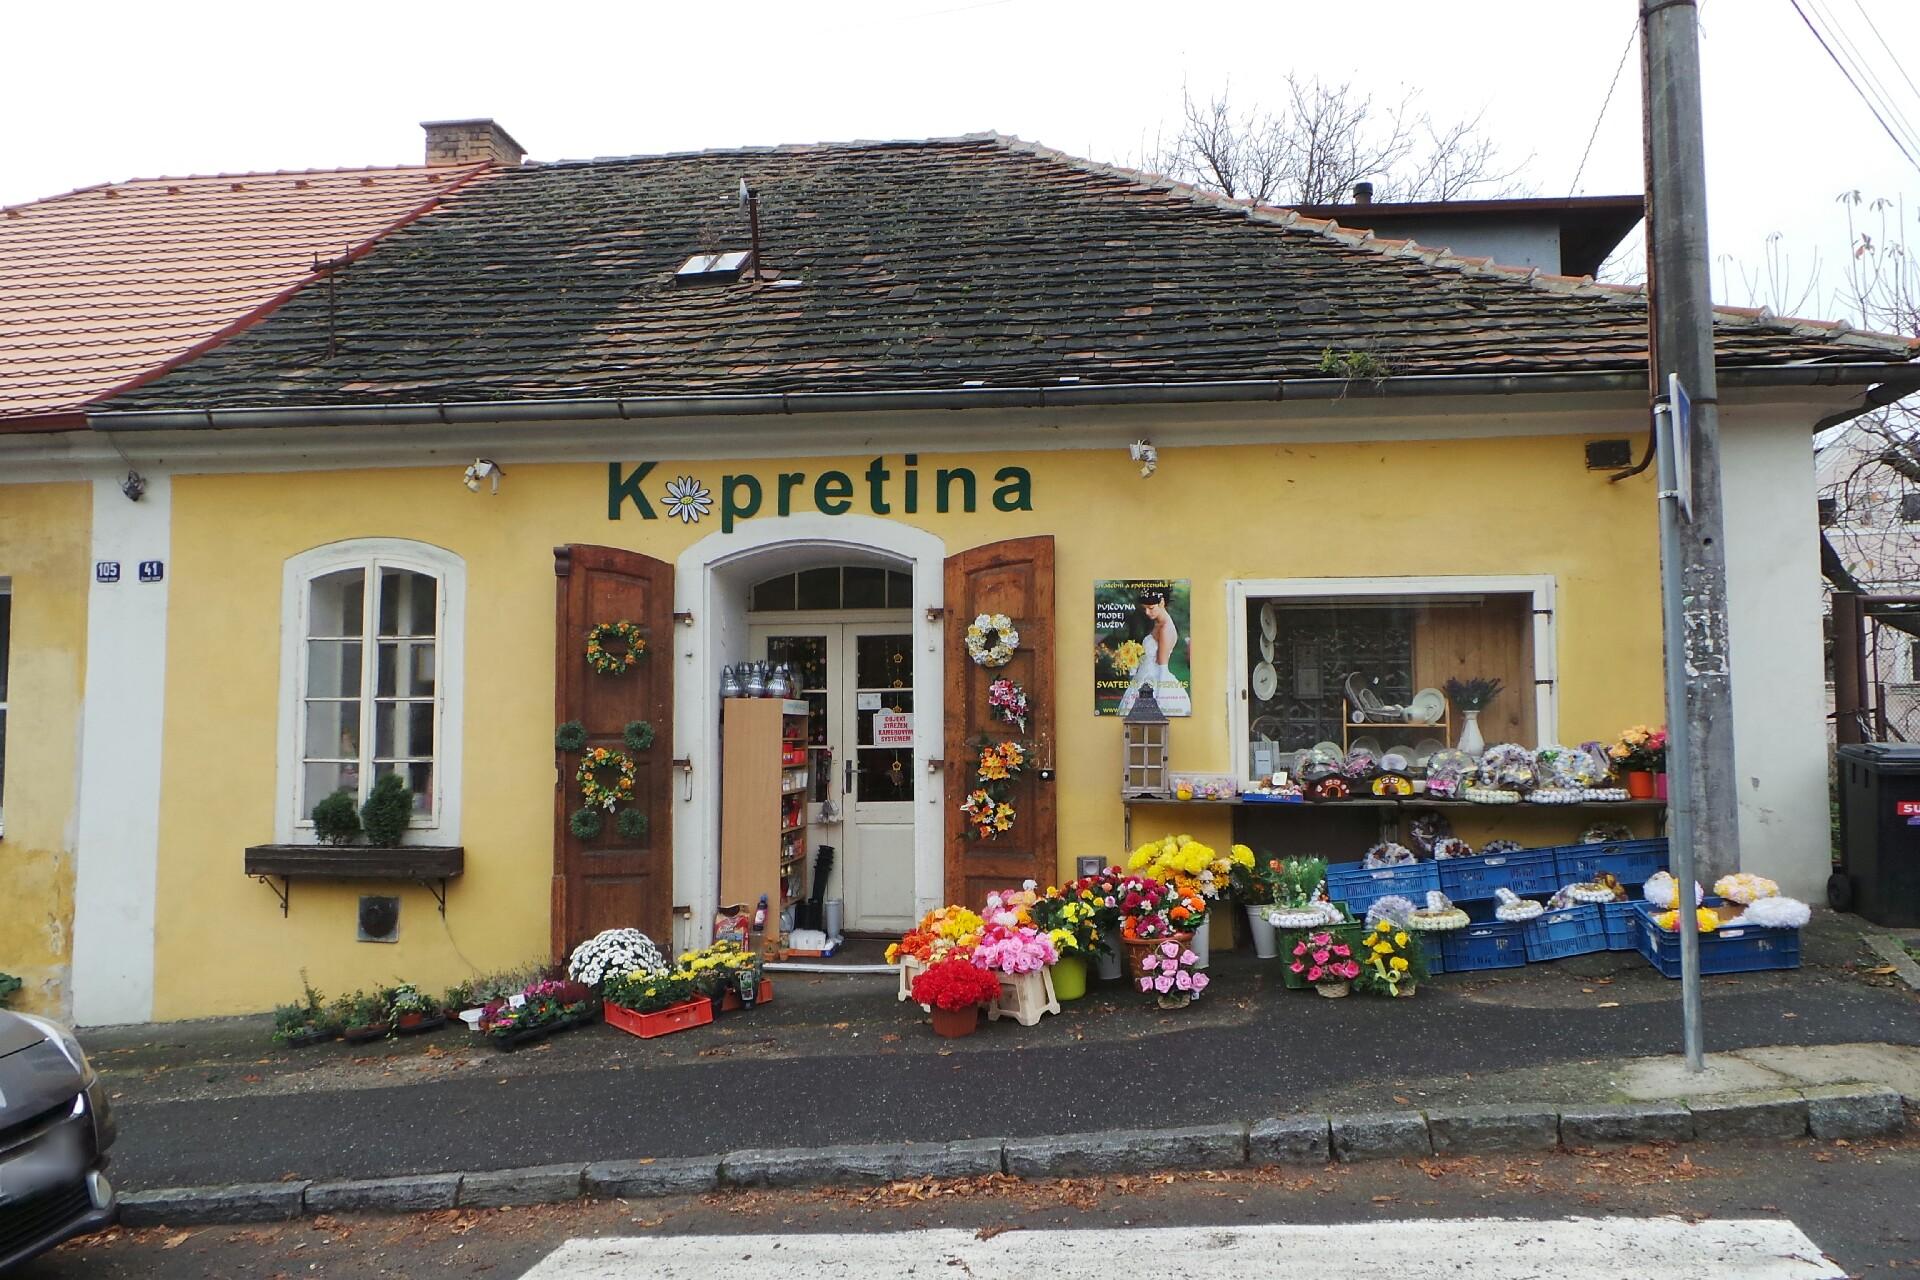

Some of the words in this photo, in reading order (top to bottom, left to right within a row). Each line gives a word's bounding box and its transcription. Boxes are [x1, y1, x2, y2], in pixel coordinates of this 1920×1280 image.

[98, 563, 117, 576] 105
[144, 563, 158, 575] 41
[1097, 612, 1125, 621] PRODEJ
[1096, 680, 1140, 689] SVATEBN
